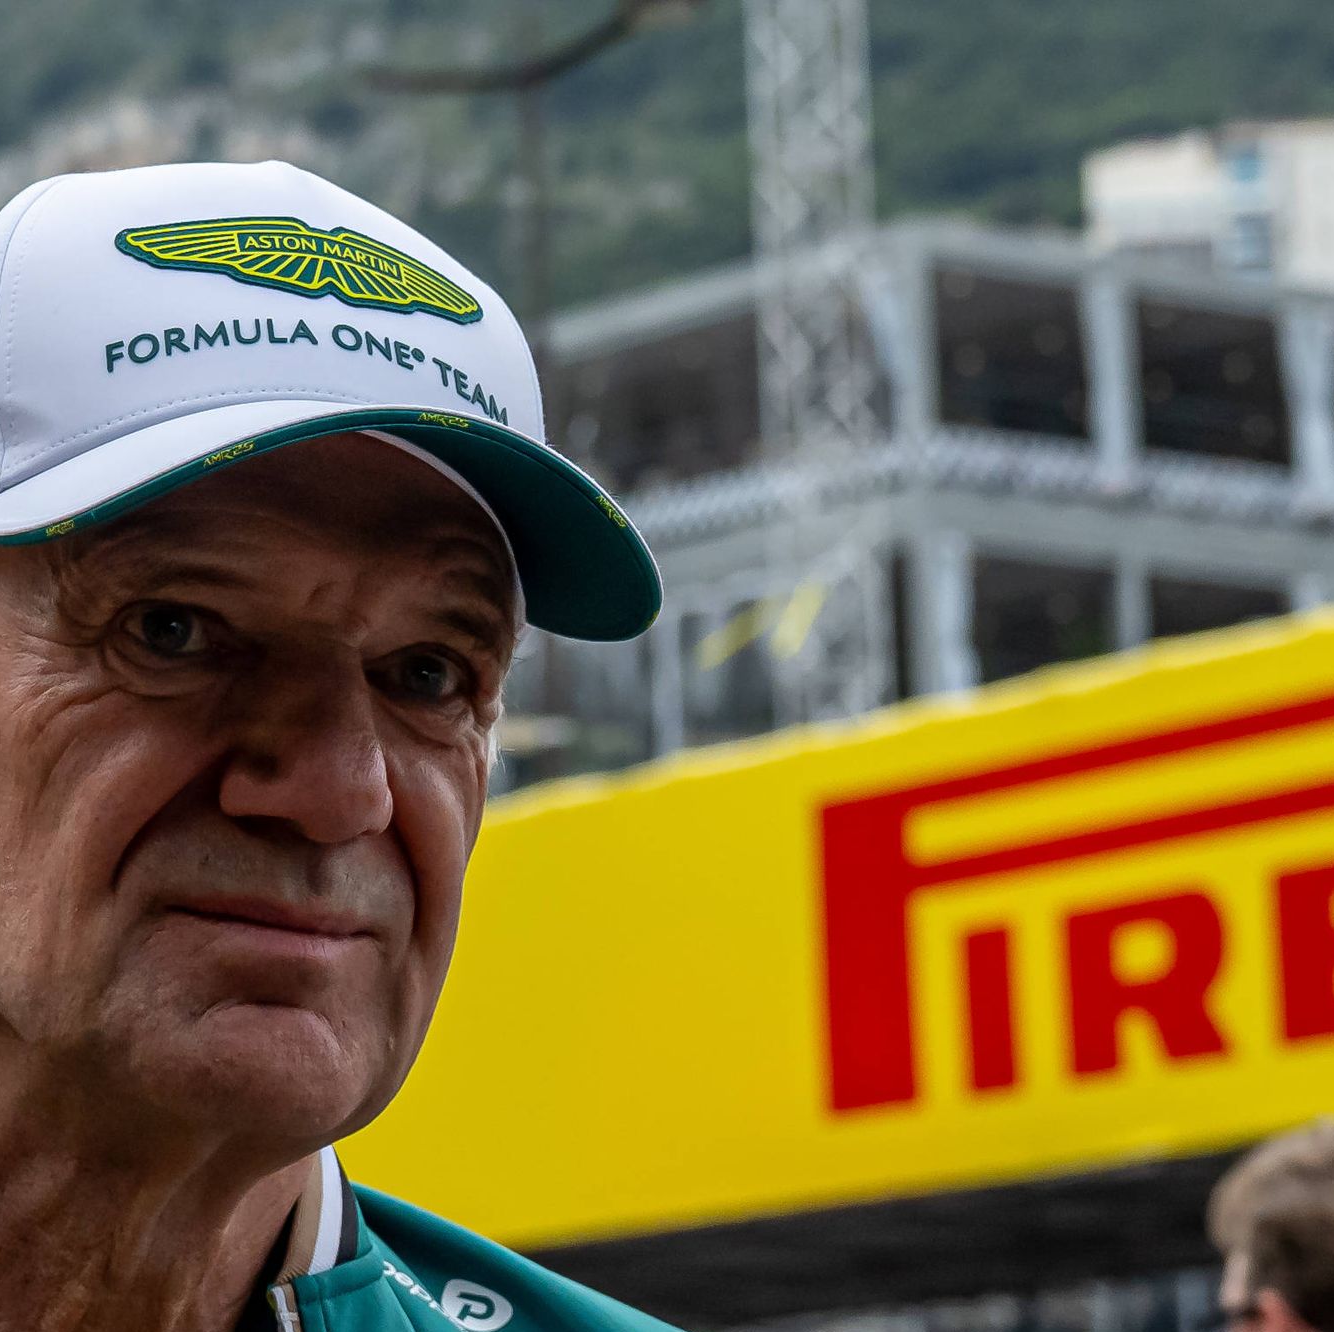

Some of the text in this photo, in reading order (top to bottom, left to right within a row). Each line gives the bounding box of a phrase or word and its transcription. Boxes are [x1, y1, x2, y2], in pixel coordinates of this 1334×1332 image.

[244, 235, 398, 277] ASTON MARTIN
[105, 318, 318, 373] FORMULA
[431, 357, 509, 427] TEAM
